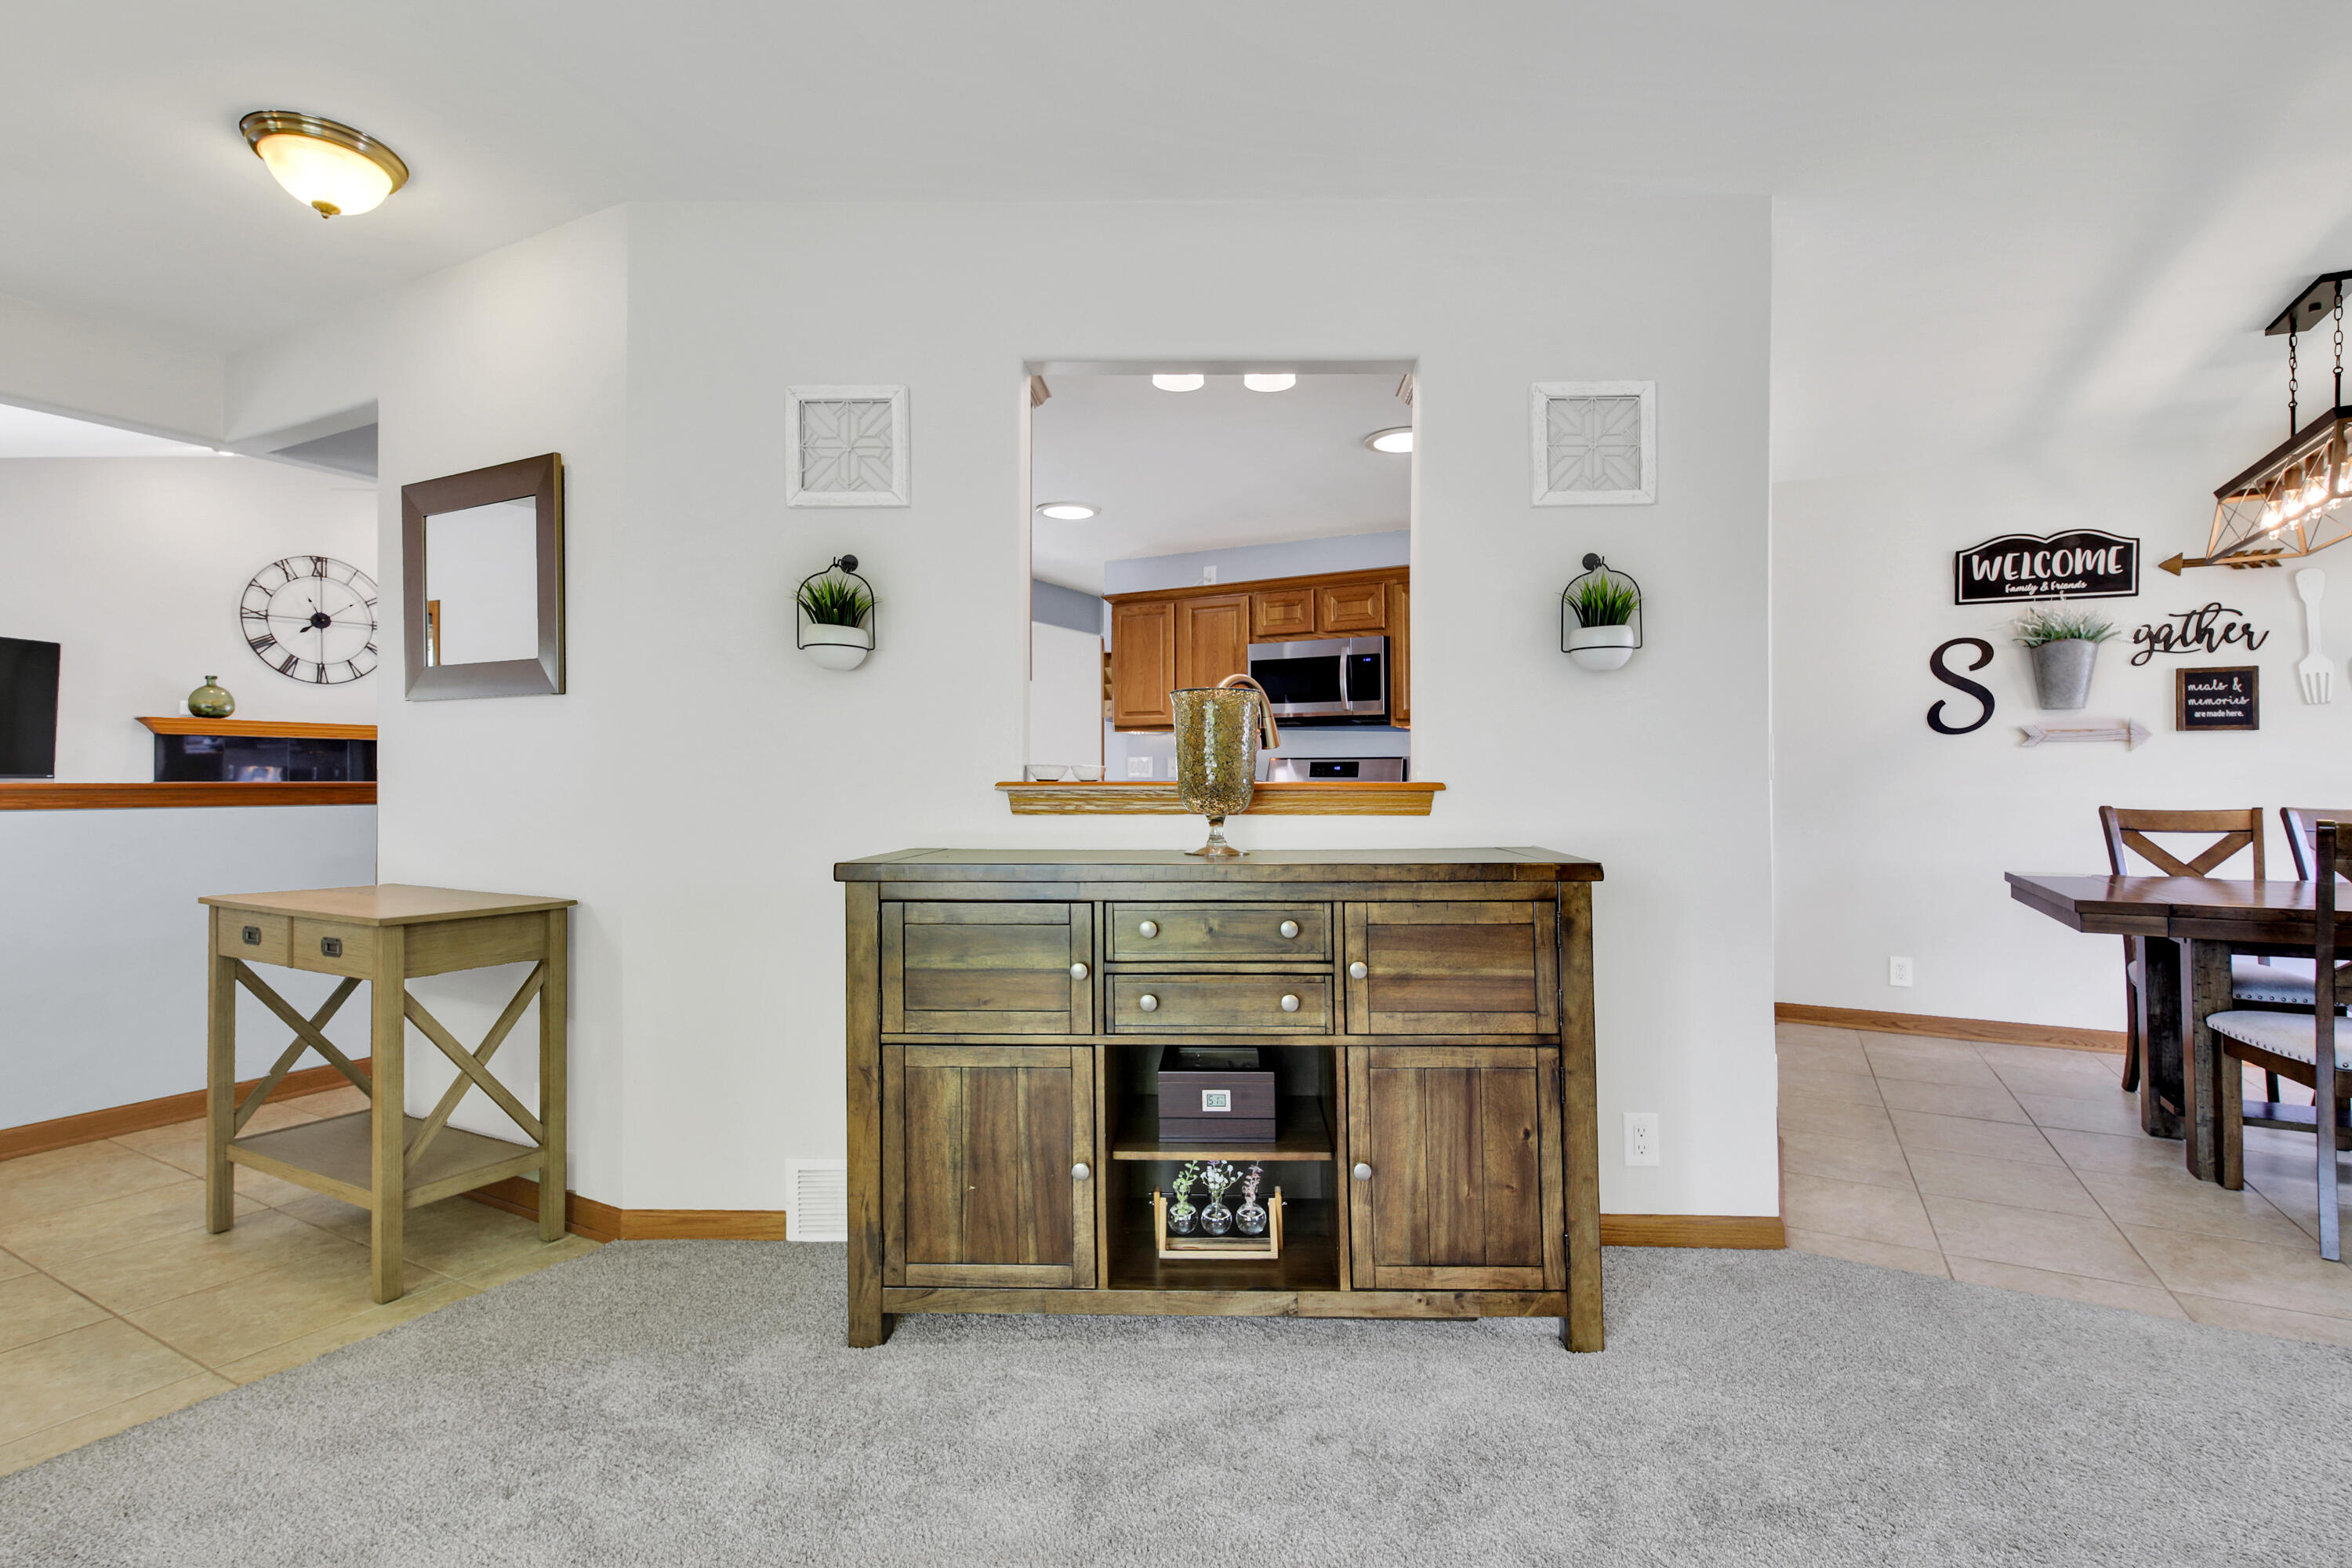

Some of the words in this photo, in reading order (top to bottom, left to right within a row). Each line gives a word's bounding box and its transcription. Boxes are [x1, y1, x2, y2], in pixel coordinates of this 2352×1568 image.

[1971, 546, 2125, 582] WELCOME
[2005, 583, 2038, 595] Family
[2040, 581, 2049, 592] &
[2050, 579, 2088, 592] Friends
[2130, 602, 2270, 666] gather
[1926, 637, 1995, 735] S
[2187, 679, 2228, 691] meals
[2232, 677, 2242, 692] &
[2187, 695, 2250, 706] memories
[2206, 709, 2225, 717] made
[2226, 709, 2245, 717] here.
